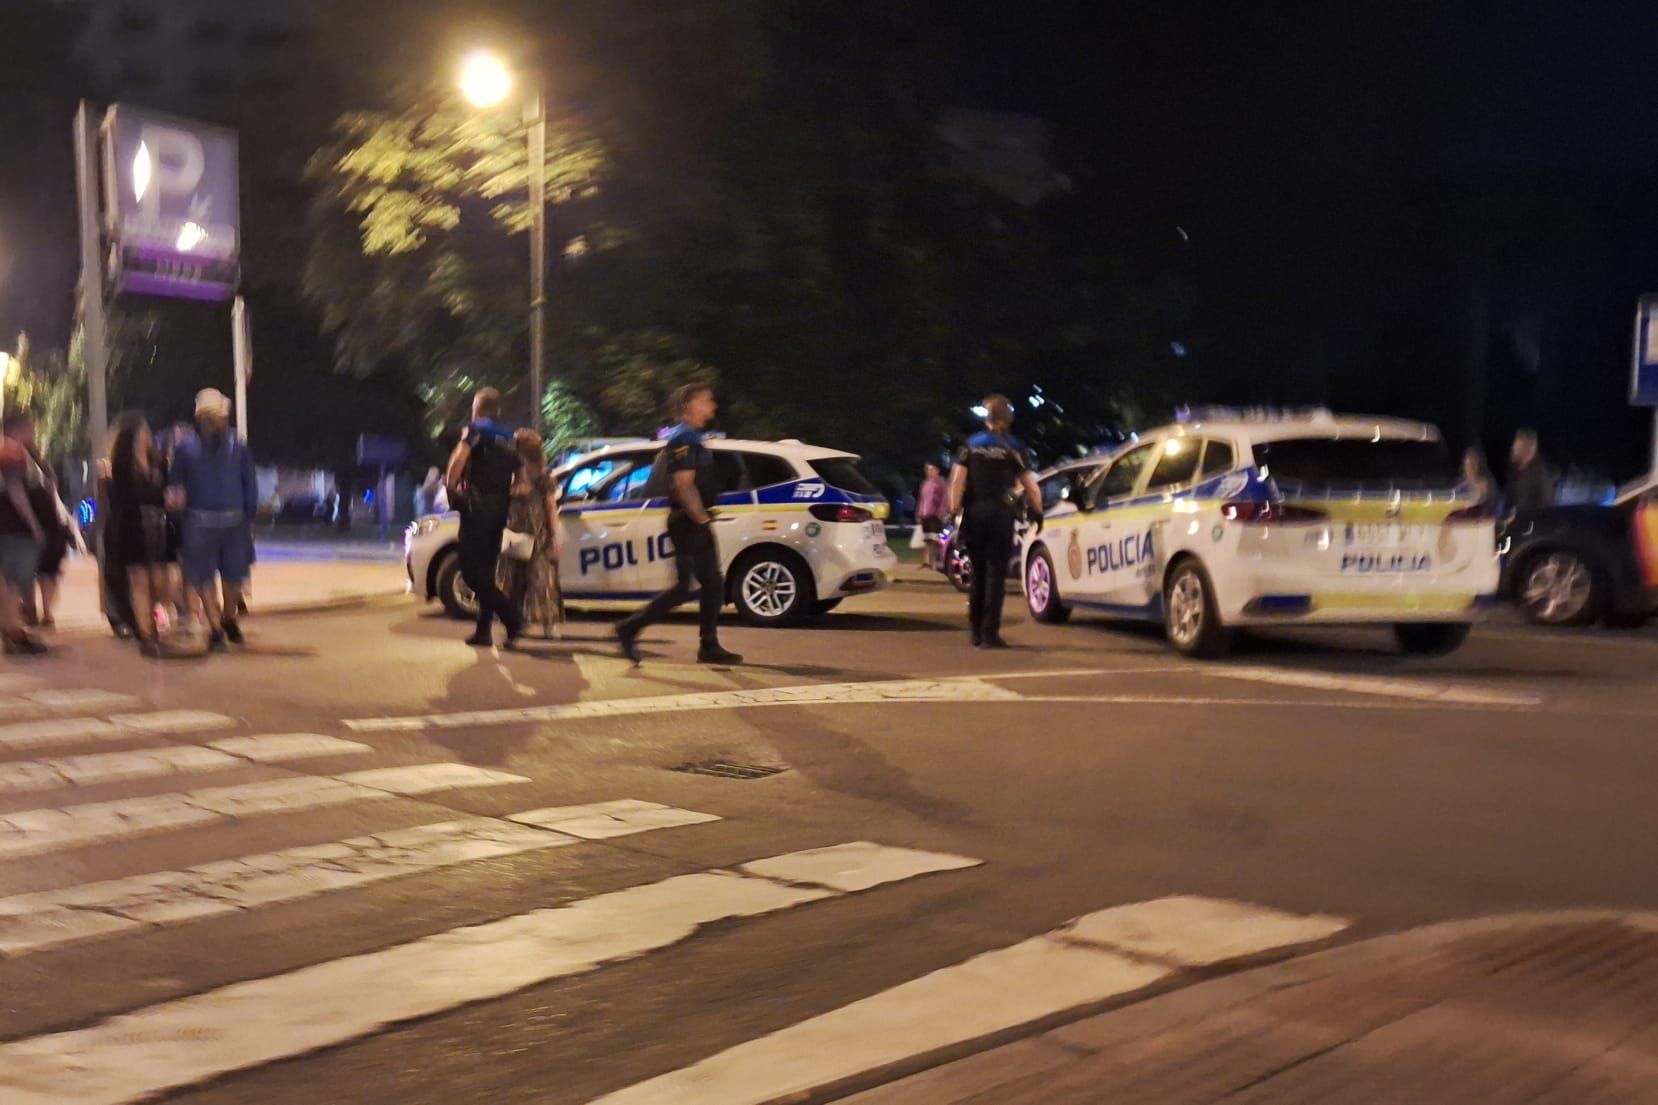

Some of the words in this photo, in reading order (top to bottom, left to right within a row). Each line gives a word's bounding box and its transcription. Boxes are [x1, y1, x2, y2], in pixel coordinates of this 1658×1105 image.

[140, 125, 205, 229] P
[579, 532, 677, 576] POLIC
[1087, 530, 1154, 576] POLICIA
